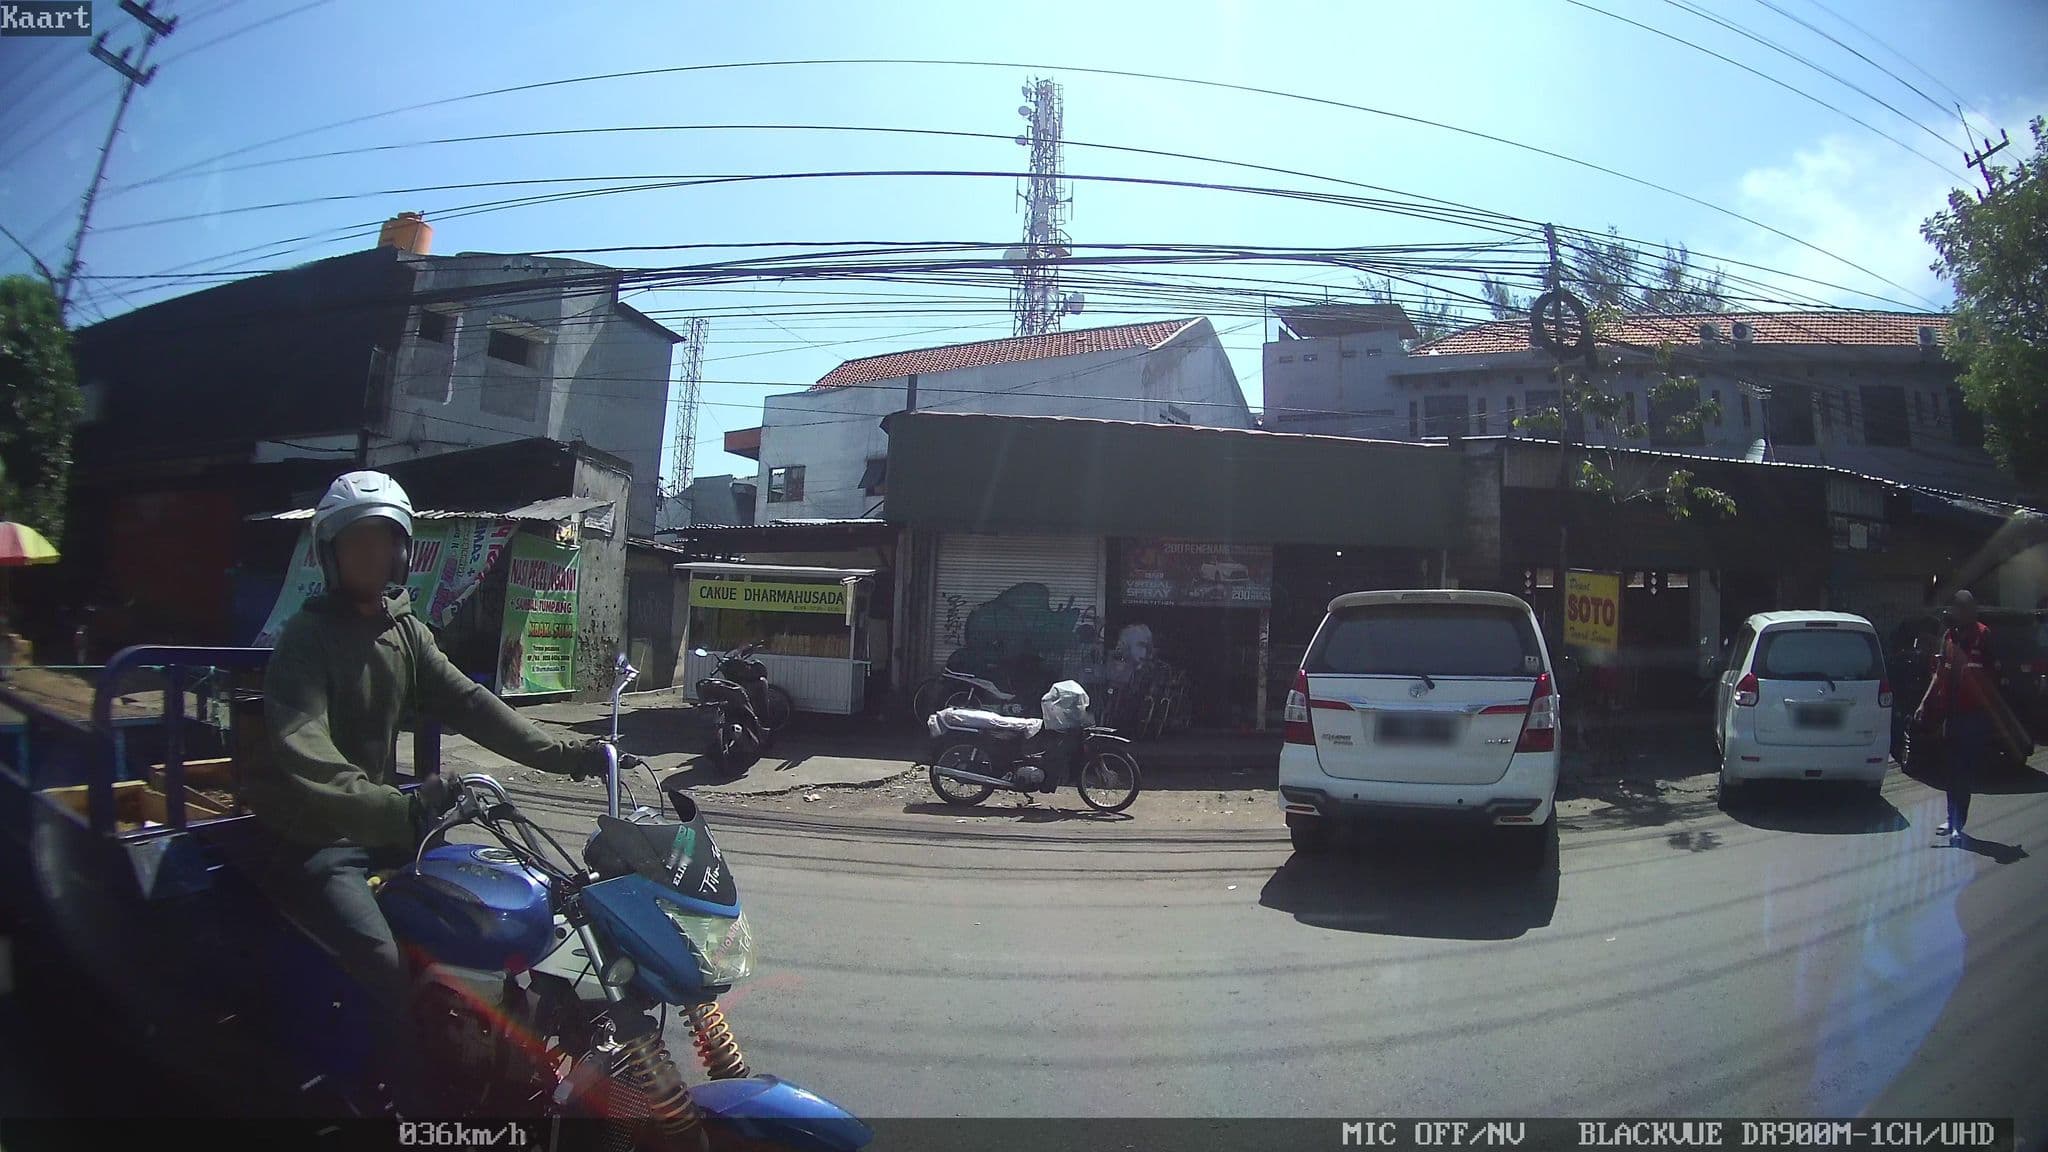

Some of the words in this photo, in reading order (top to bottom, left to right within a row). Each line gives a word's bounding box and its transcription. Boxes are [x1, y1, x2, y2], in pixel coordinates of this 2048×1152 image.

[510, 559, 529, 587] NASI
[699, 585, 737, 601] CAKUE
[743, 588, 845, 606] DHARMAHUSADA
[1126, 587, 1171, 597] SPRAY
[538, 600, 572, 614] TUMPANG
[1567, 593, 1616, 627] SOTO
